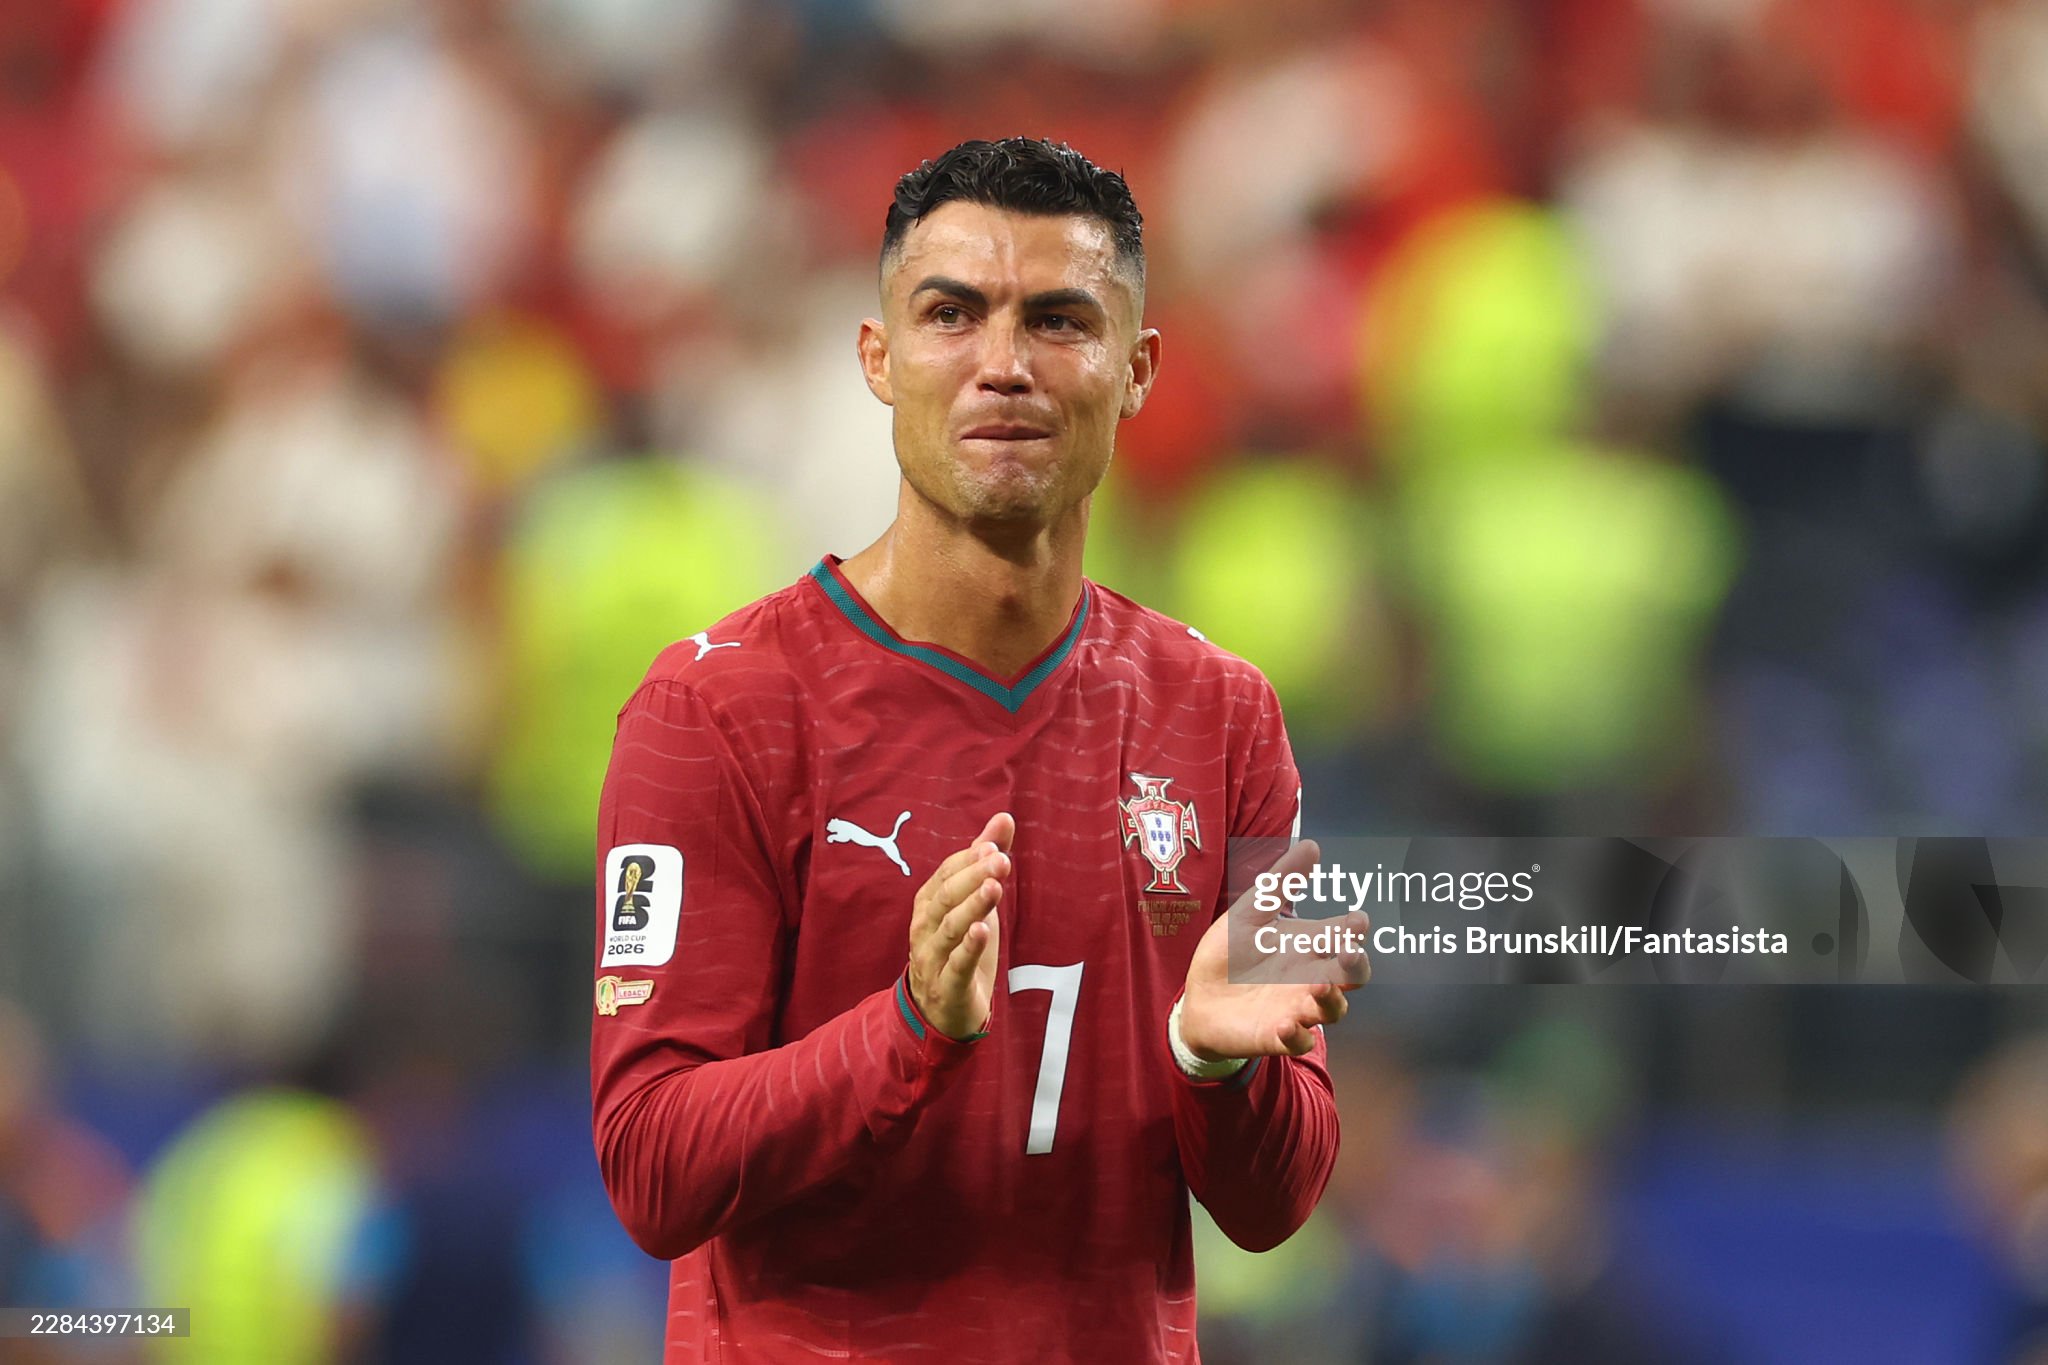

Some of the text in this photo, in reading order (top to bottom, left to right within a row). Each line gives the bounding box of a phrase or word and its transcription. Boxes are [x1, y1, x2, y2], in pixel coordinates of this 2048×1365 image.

[618, 915, 637, 925] FIFA
[608, 943, 645, 955] 2026
[1008, 961, 1084, 1155] 7
